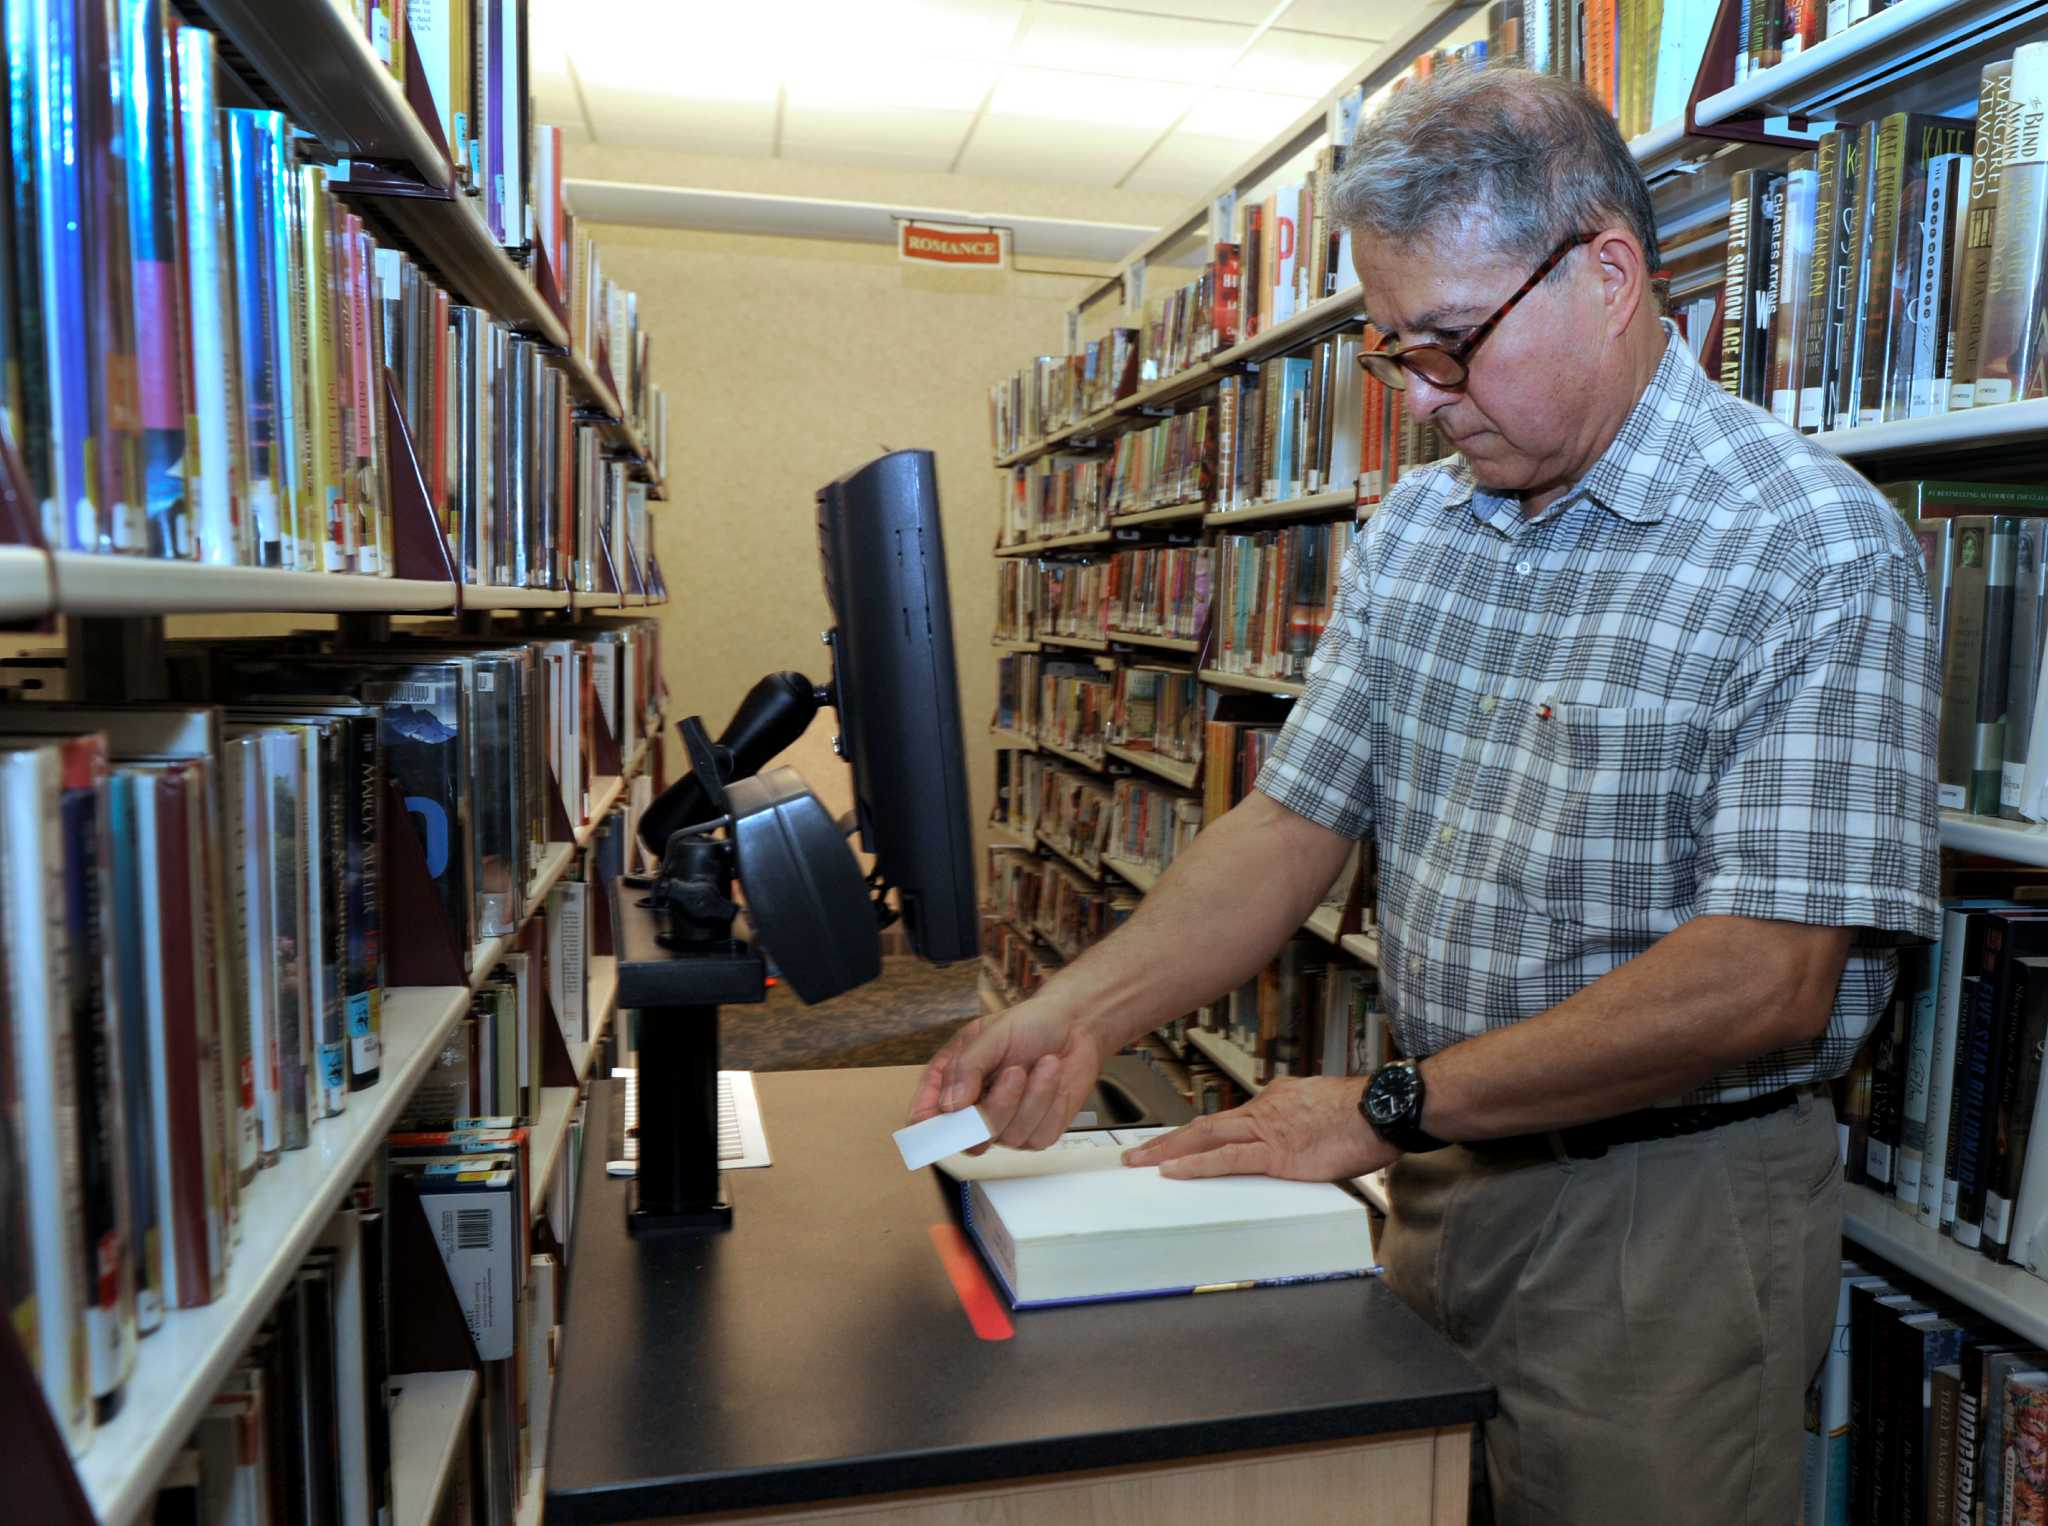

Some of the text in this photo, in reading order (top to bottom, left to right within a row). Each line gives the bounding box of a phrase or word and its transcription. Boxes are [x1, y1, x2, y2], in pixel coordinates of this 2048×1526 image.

[1819, 143, 1835, 187] KATE
[1971, 78, 1995, 199] ATWOOD
[1987, 75, 2011, 193] MARGARET
[2004, 100, 2025, 160] ASSASSIN
[2021, 112, 2044, 157] BLIND
[908, 236, 997, 256] ROMANCE
[1728, 197, 1748, 249] WHITE
[1767, 193, 1783, 314] CHARLES ATKINS
[1809, 201, 1831, 297] ATKINSON
[1724, 253, 1745, 320] SHADOW
[1966, 258, 1989, 366] ALIAS GRACE
[1722, 327, 1741, 355] ACE
[360, 763, 376, 833] MARCIA
[361, 841, 376, 914] MULLER
[1959, 982, 1994, 1195] FIVE STAR BILLIONAIRE
